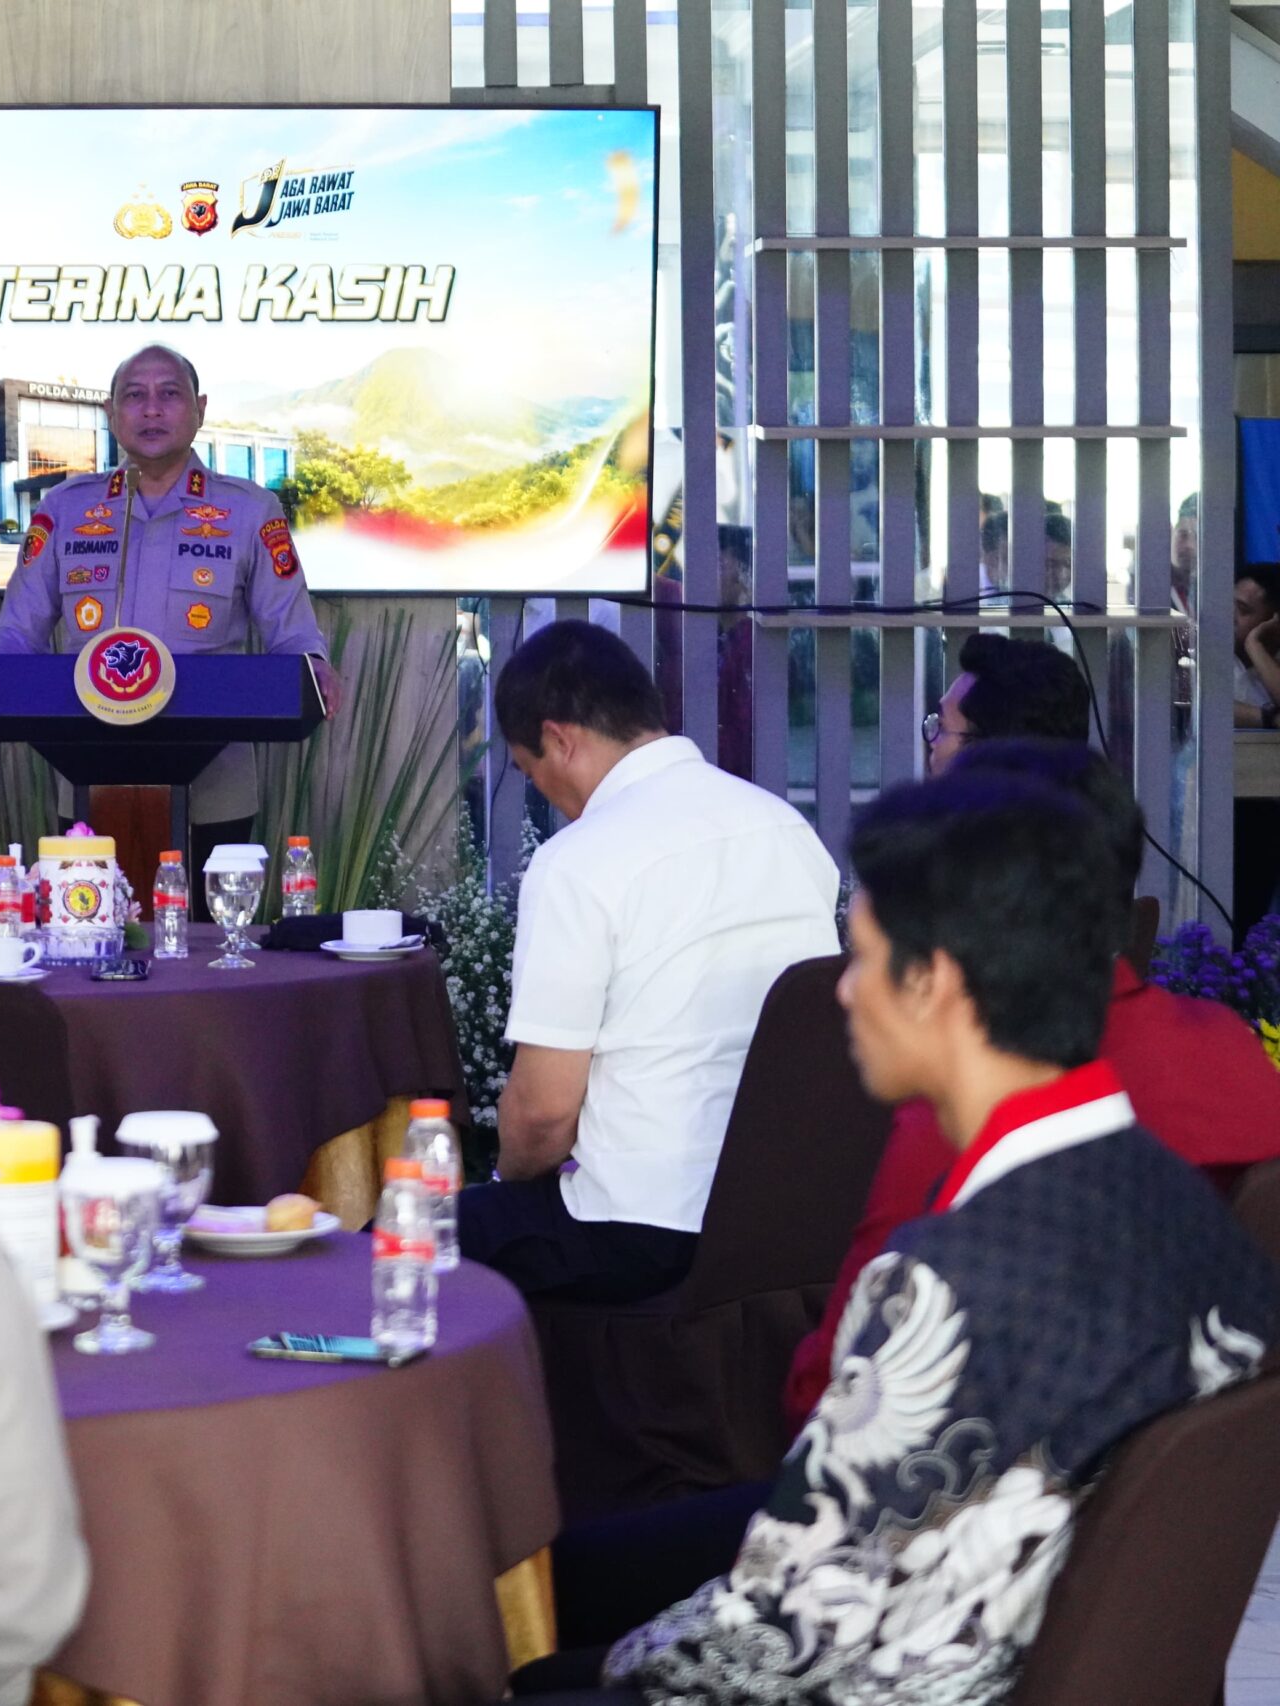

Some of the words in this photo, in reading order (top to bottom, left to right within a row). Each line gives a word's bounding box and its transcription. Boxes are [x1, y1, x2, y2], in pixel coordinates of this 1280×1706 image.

[309, 171, 355, 194] RAWAT
[264, 198, 311, 228] JAWA
[313, 191, 355, 215] BARAT
[238, 264, 456, 322] KASIH
[28, 383, 69, 398] POLDA
[261, 520, 286, 537] POLDA
[178, 543, 232, 560] POLRI
